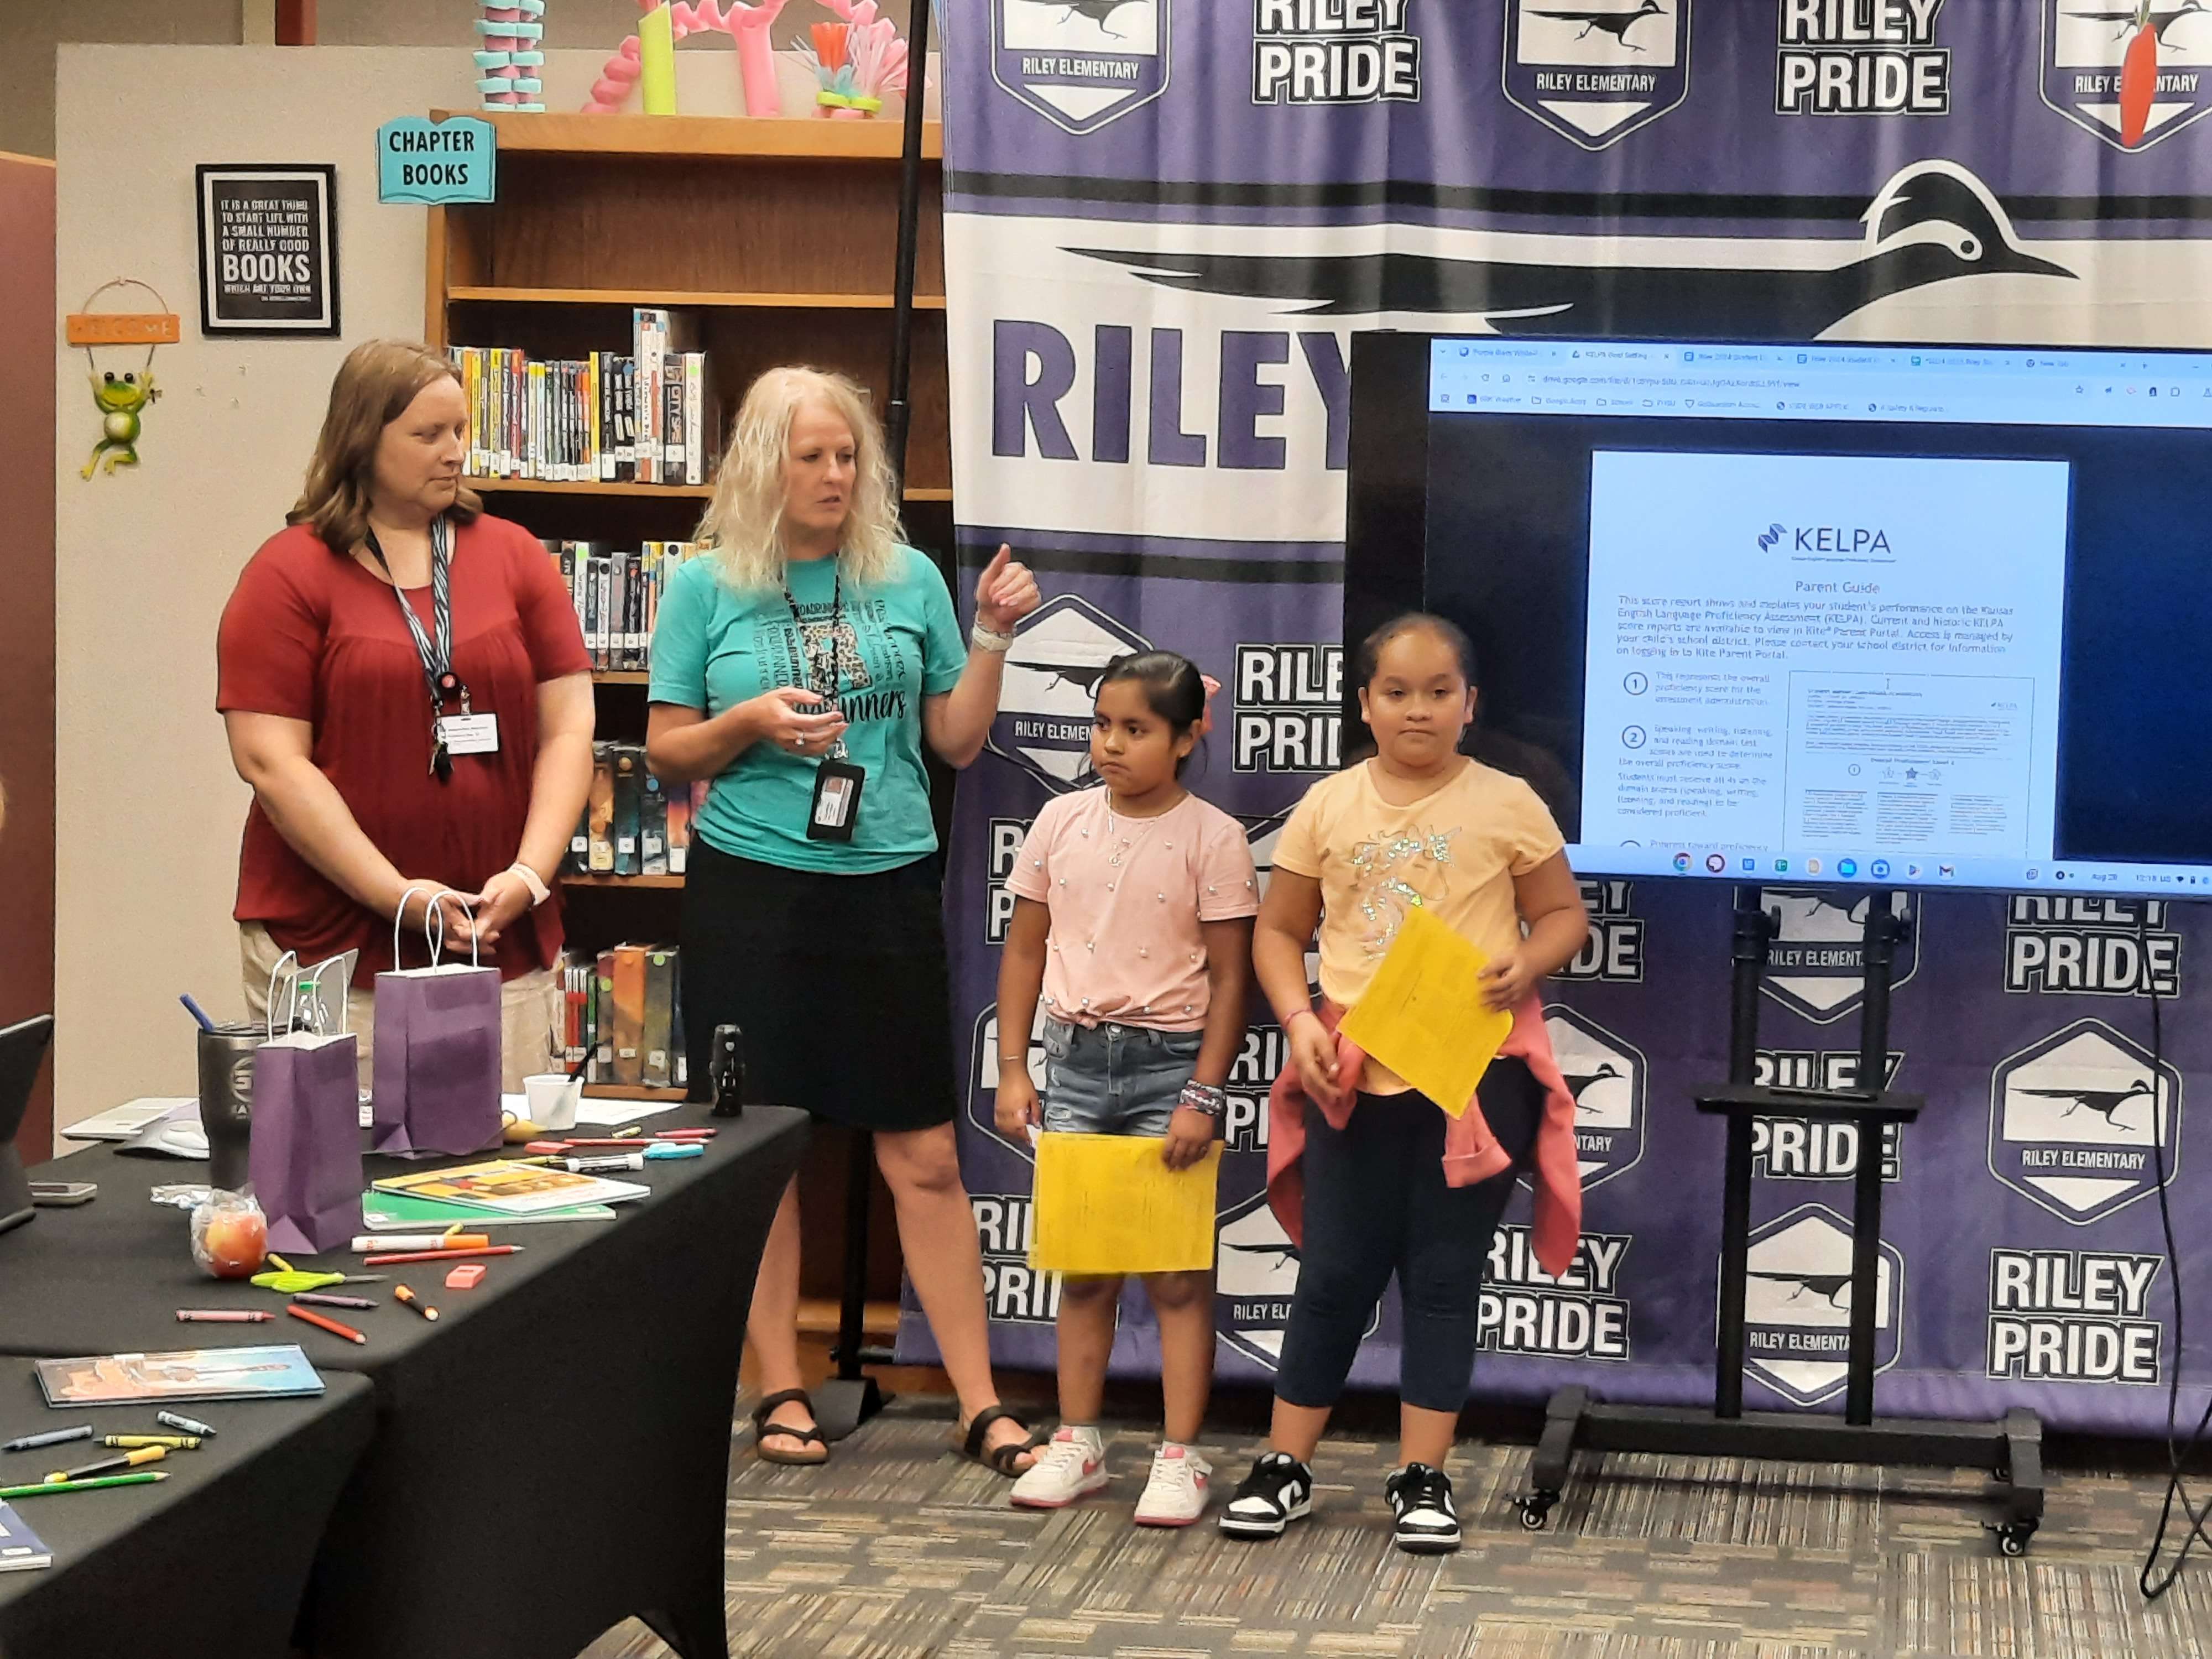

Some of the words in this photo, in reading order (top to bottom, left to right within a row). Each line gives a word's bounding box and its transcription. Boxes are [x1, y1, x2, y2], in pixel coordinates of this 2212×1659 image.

[1784, 0, 1943, 41] RILEY
[1022, 58, 1057, 76] RILEY
[1058, 59, 1139, 80] ELEMENTARY
[1259, 42, 1415, 97] PRIDE
[1536, 72, 1573, 91] RILEY
[1576, 74, 1656, 93] ELEMENTARY
[1782, 56, 1946, 109] PRIDE
[2075, 75, 2110, 93] RILEY
[2114, 73, 2199, 92] ENTARY
[389, 131, 474, 153] CHAPTER
[403, 164, 468, 185] BOOKS
[243, 200, 249, 210] A
[223, 212, 233, 223] TO
[236, 212, 263, 223] START
[223, 225, 229, 237] A
[231, 225, 265, 237] SMALL
[223, 239, 235, 251] OF
[238, 239, 276, 251] REALLY
[279, 239, 310, 252] GOOD
[223, 254, 310, 282] BOOKS
[1795, 528, 1891, 554] KELPA
[1796, 581, 1837, 593] Parent
[1843, 582, 1880, 594] Guide
[1804, 603, 1825, 612] your
[1912, 617, 1929, 625] and
[1696, 649, 1714, 658] Kite
[1832, 642, 1853, 651] your
[1932, 643, 1945, 651] for
[1242, 652, 1343, 701] RILE
[1015, 721, 1045, 738] RILEY
[1047, 723, 1092, 741] ELEMEN
[1240, 717, 1342, 765] PRI
[1768, 950, 1801, 966] RILEY
[1806, 950, 1864, 966] ELEMENT
[2012, 937, 2174, 990] PRIDE
[1573, 1135, 1612, 1151] NTARY
[2023, 1150, 2060, 1166] RILEY
[2062, 1151, 2146, 1170] ELEMENTARY
[1996, 1256, 2153, 1312] RILEY
[1233, 1303, 1268, 1320] RILEY
[1476, 1295, 1623, 1353] PRIDE
[1750, 1332, 1785, 1349] RILEY
[1789, 1333, 1850, 1351] ELEMENTA
[1994, 1322, 2154, 1378] PRIDE
